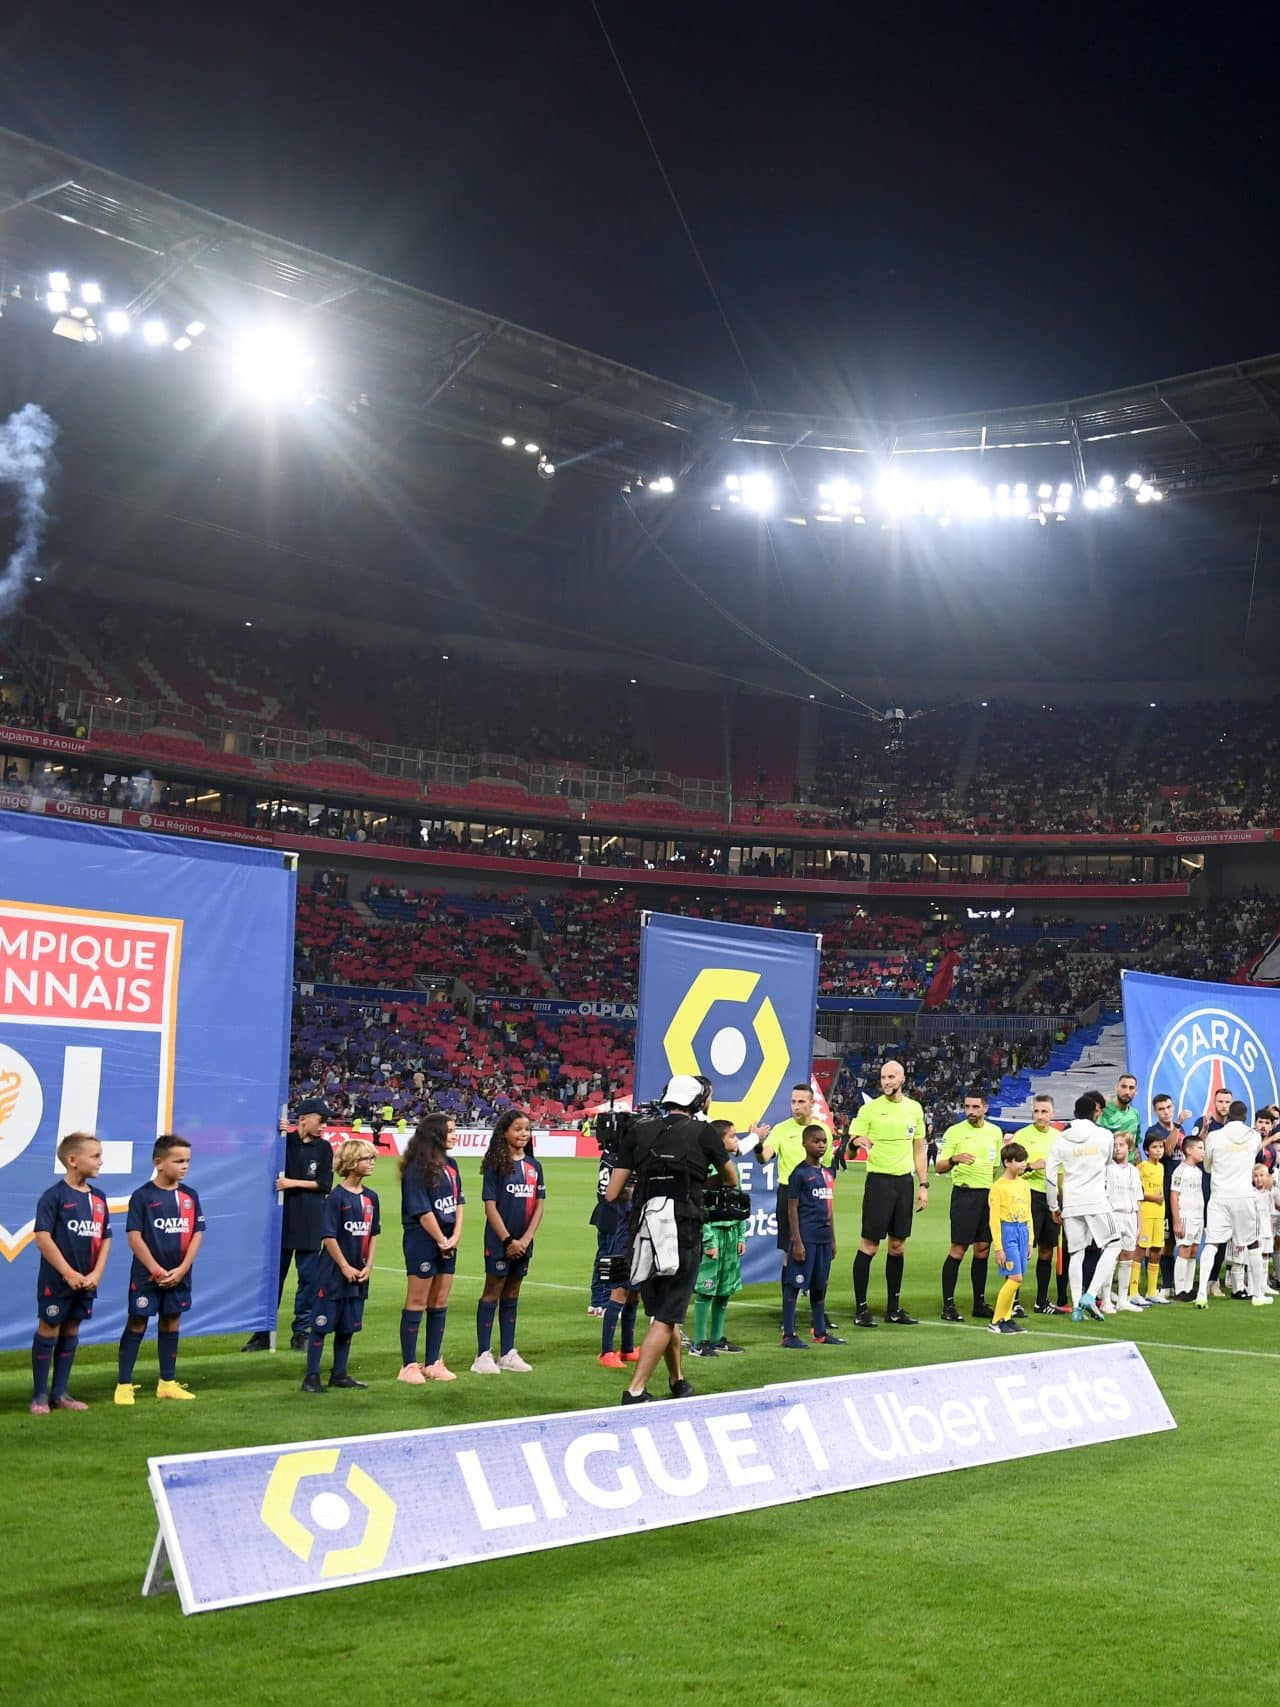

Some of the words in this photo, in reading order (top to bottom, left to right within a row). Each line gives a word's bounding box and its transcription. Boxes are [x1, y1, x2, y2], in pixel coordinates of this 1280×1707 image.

[42, 739, 86, 752] STADIUM
[56, 801, 106, 819] Orange
[153, 818, 165, 828] La
[1176, 833, 1218, 843] Groupama
[4, 967, 152, 1013] NNAIS
[1170, 1019, 1258, 1073] PARIS
[763, 1163, 774, 1190] 1
[67, 1219, 102, 1231] QATAR
[154, 1217, 189, 1230] QATAR
[744, 1208, 778, 1237] ats
[455, 1412, 775, 1531] LIGUE
[781, 1403, 830, 1471] 1
[844, 1391, 996, 1462] Uber
[993, 1369, 1131, 1435] Eats
